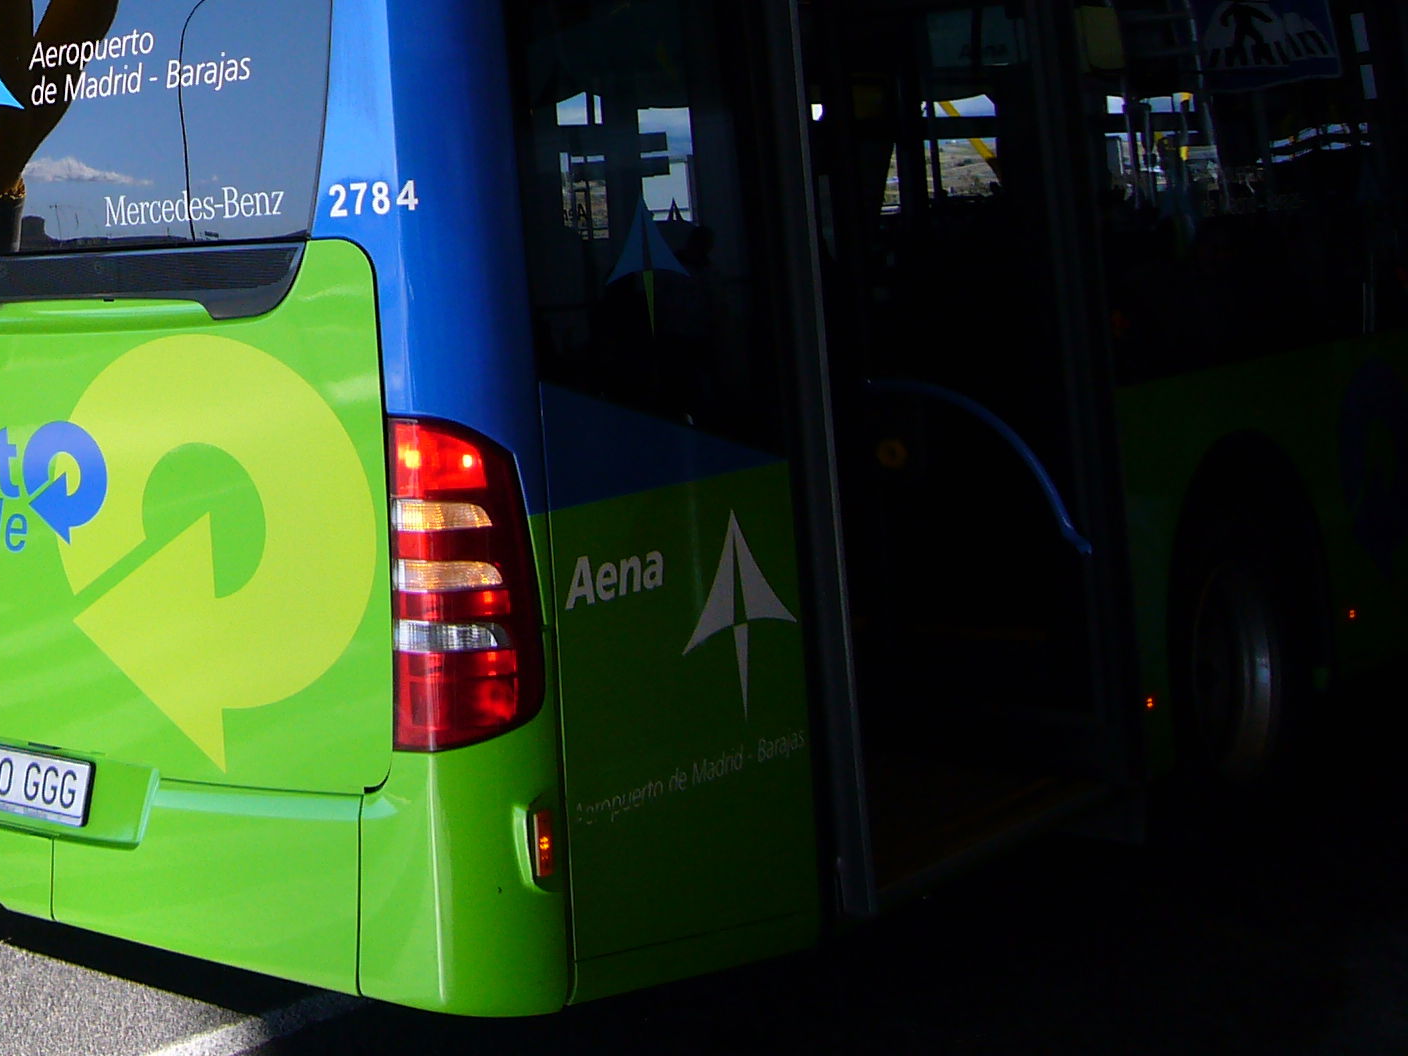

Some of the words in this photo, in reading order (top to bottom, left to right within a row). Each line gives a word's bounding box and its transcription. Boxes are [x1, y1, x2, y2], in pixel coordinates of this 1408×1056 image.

[29, 29, 155, 72] Aeropuerto
[30, 76, 57, 108] de
[63, 67, 142, 102] Madrid
[166, 52, 252, 96] Barajas
[103, 187, 285, 228] Mercedes-Benz
[328, 179, 419, 219] 2784
[565, 549, 664, 612] Aena
[669, 767, 688, 792] de
[692, 744, 744, 787] Madrid
[757, 729, 806, 763] Barajas
[23, 761, 78, 810] GGG
